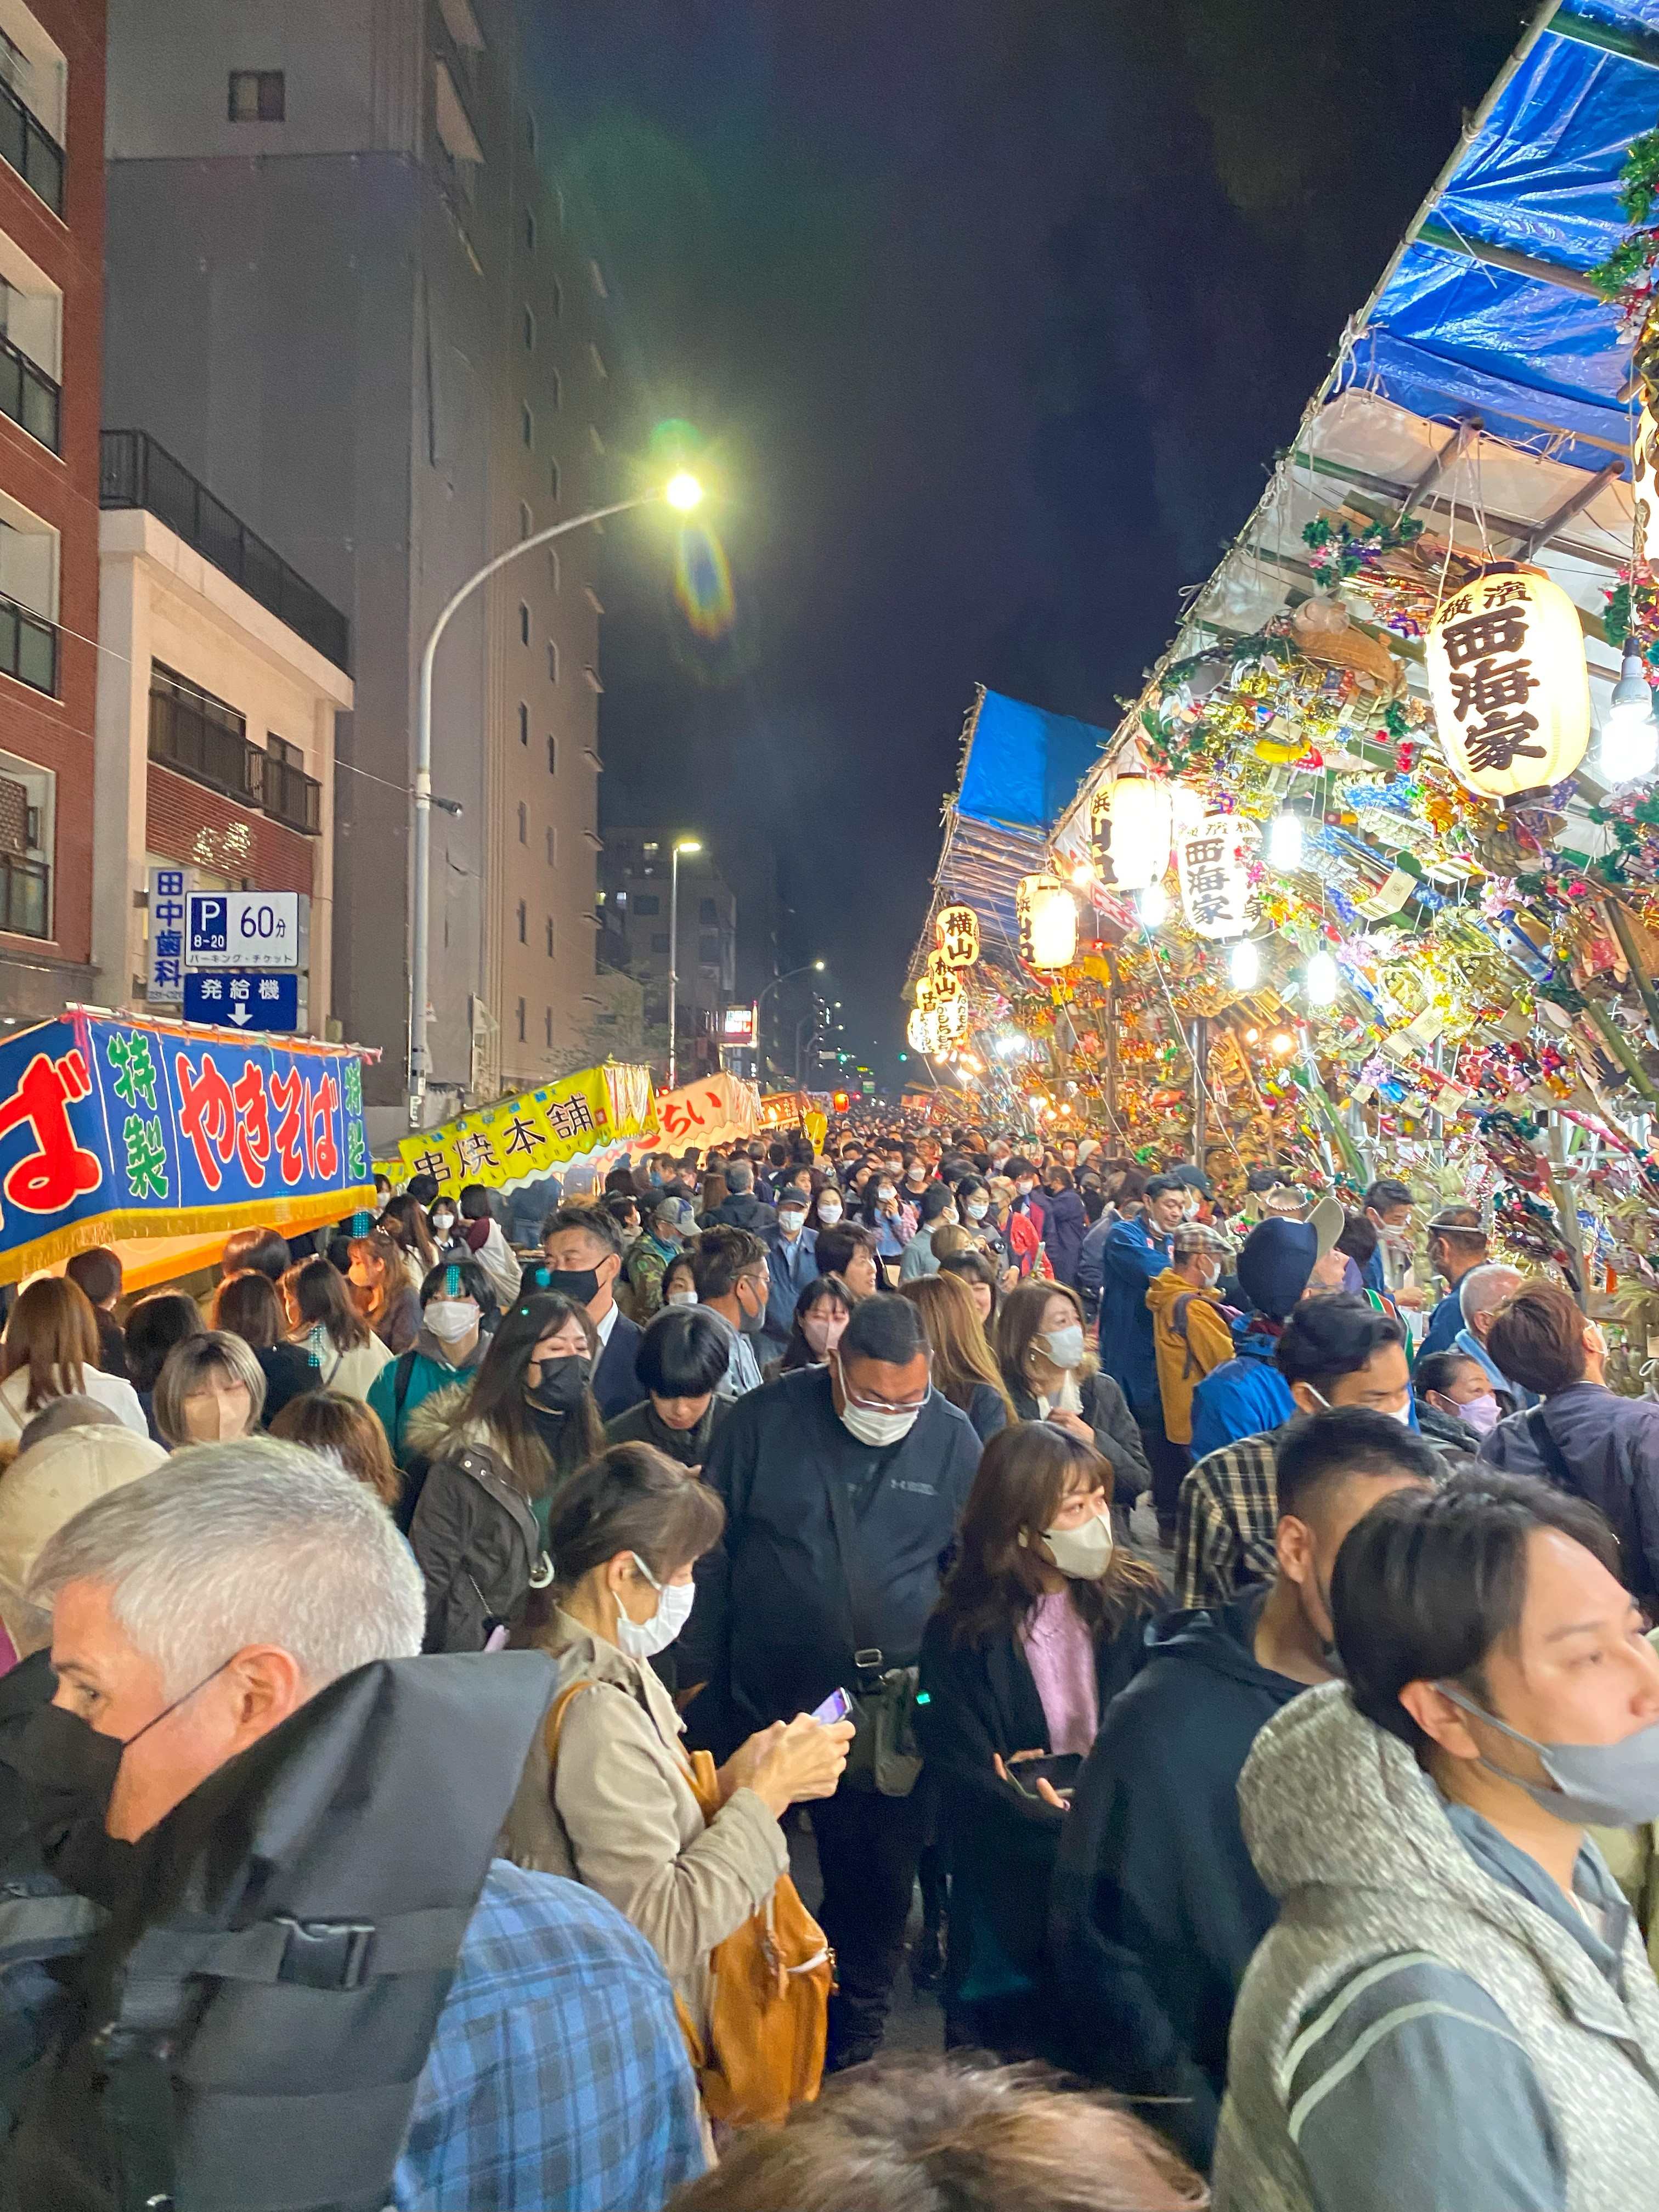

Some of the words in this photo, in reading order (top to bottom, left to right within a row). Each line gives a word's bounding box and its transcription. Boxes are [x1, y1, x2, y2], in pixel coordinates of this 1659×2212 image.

[1442, 606, 1547, 772] 西海家
[201, 900, 221, 932] P
[240, 906, 286, 939] 60分
[1185, 837, 1234, 925] 西海家
[154, 871, 183, 988] 田中歯科
[194, 934, 225, 948] 8-20
[945, 911, 973, 960] 横山
[200, 978, 280, 1000] 発給機
[106, 1029, 170, 1200] 特製
[175, 1051, 340, 1192] やきそば
[413, 1091, 596, 1183] 串焼本舗
